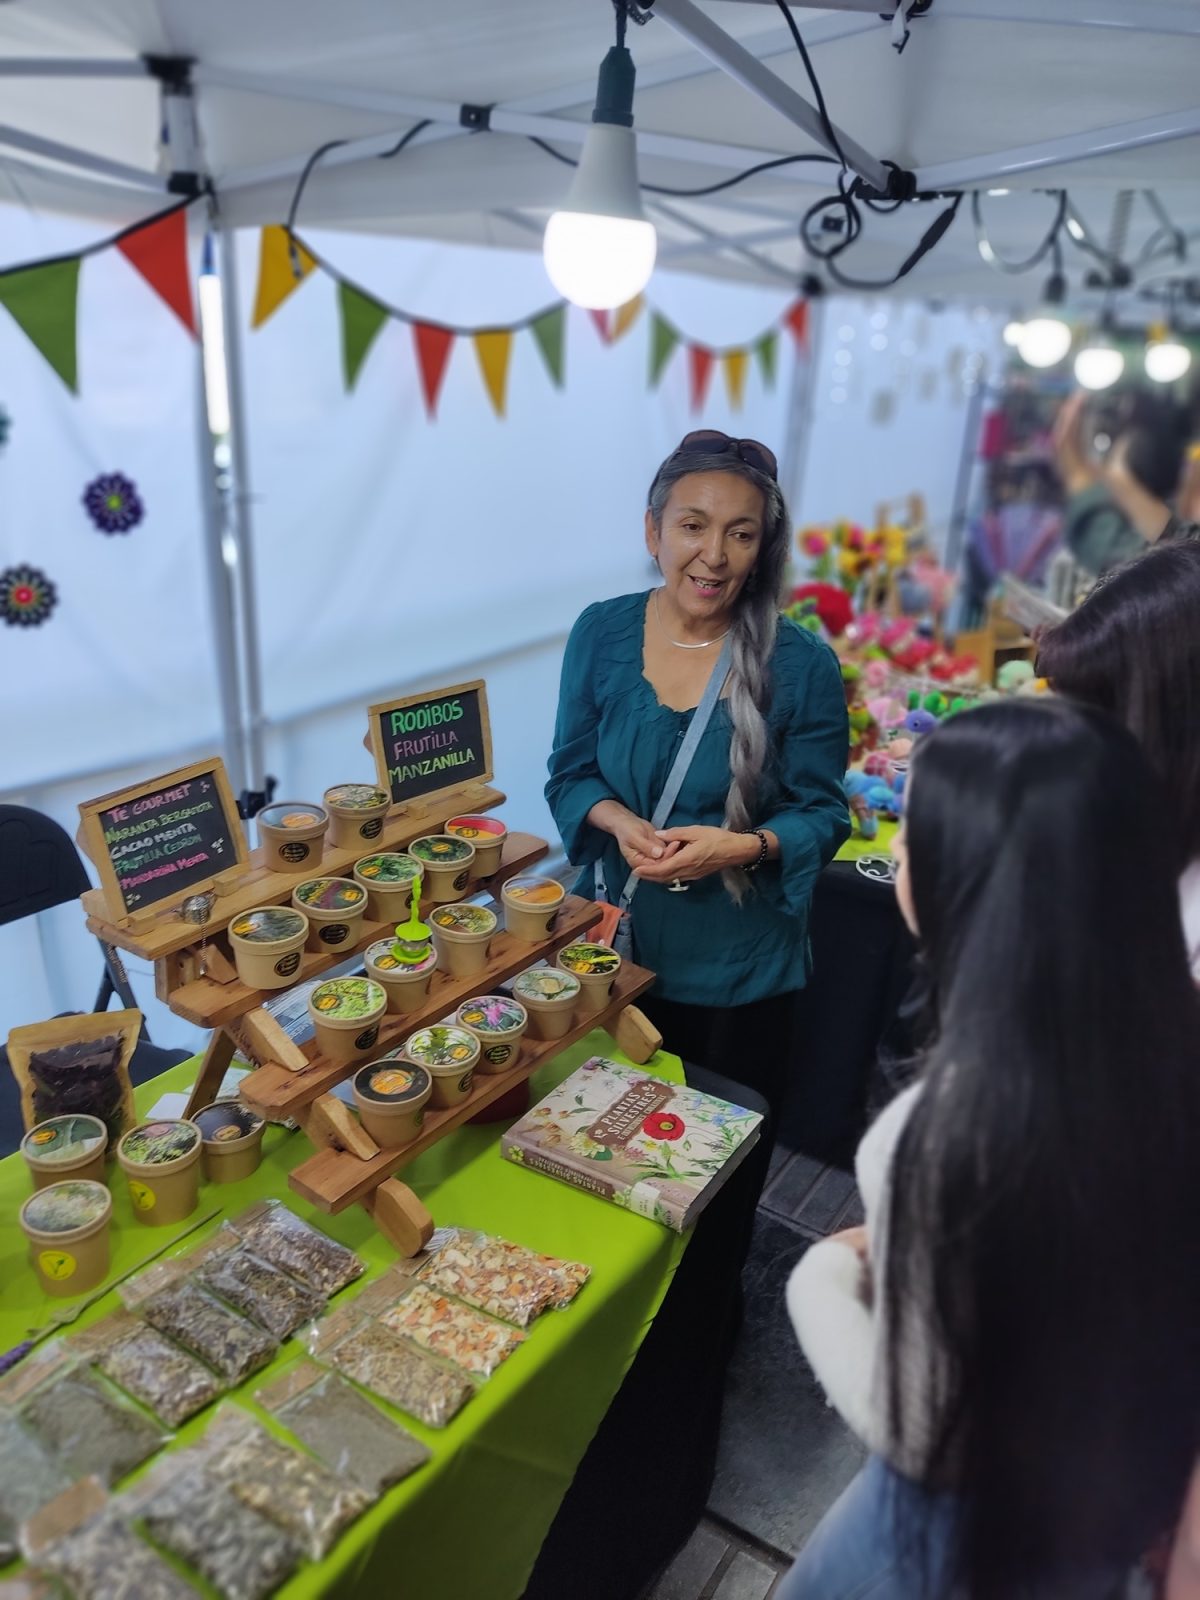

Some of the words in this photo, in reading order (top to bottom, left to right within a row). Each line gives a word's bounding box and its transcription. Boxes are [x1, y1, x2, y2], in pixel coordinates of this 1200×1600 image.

[390, 699, 464, 737] ROOIBOS
[393, 730, 459, 761] FRUTILLA
[388, 747, 475, 786] MANZANILLA
[132, 783, 192, 816] GOURMET
[110, 837, 154, 859] CACAO
[601, 1092, 640, 1125] PLANTAS
[607, 1091, 657, 1135] SILVESTRES
